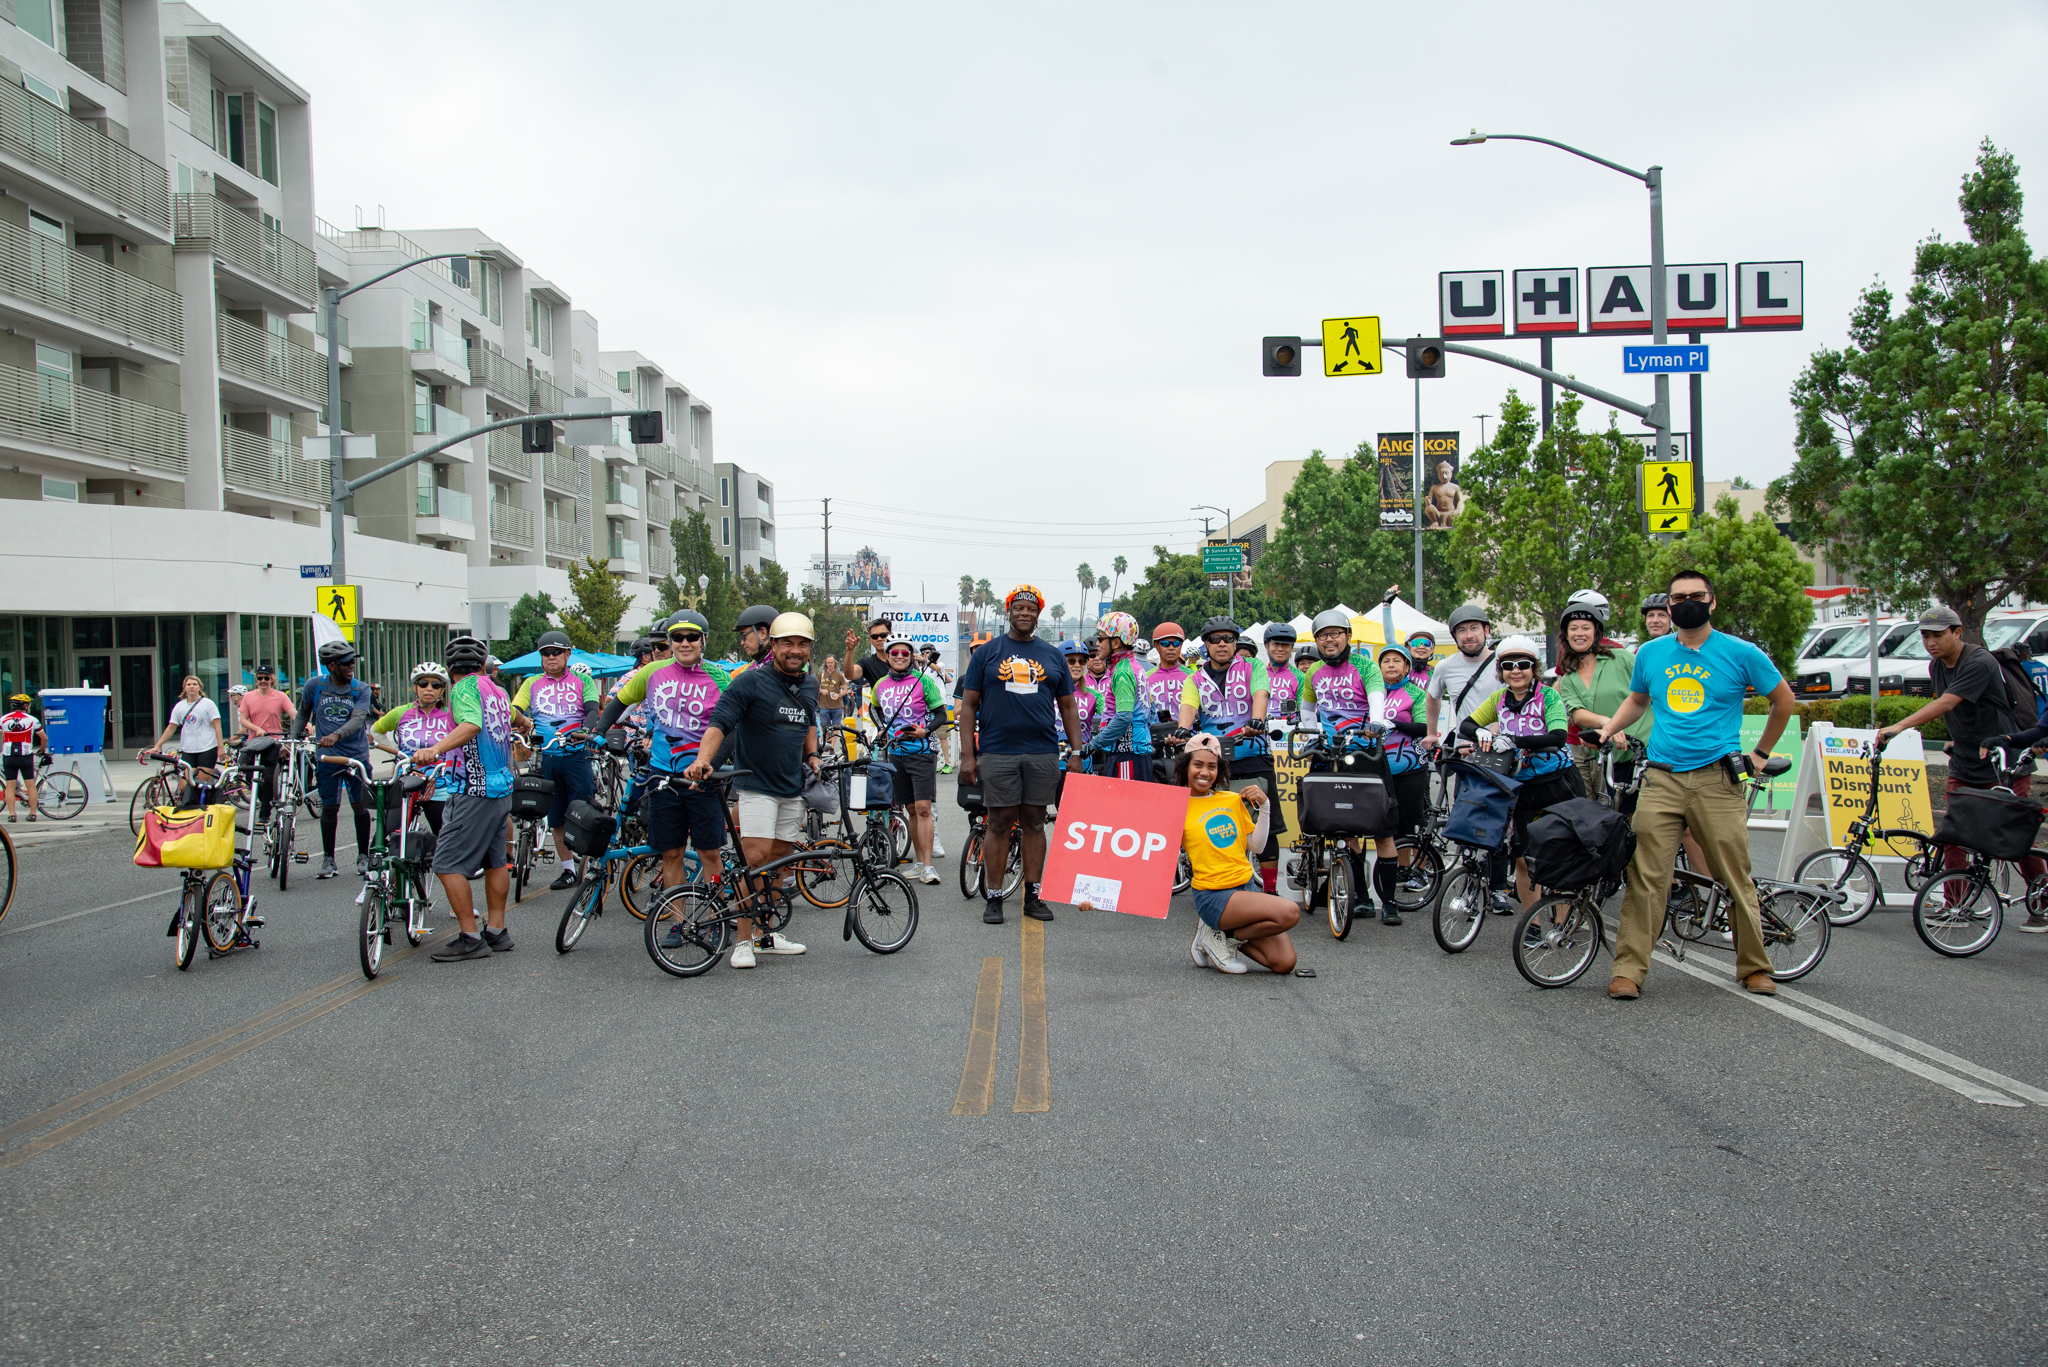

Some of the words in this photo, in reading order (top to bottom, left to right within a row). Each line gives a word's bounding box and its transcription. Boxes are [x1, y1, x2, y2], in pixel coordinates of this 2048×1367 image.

[1629, 352, 1683, 369] Lyman
[301, 565, 321, 575] Lyman
[1016, 591, 1036, 602] LONDON
[881, 611, 950, 622] CICLAVIA
[891, 624, 917, 632] MEET
[922, 624, 941, 632] THE
[911, 635, 949, 643] WOODS
[1665, 663, 1711, 679] STAFF
[1225, 670, 1246, 684] UN
[1272, 677, 1291, 688] UN
[1333, 673, 1353, 687] UN
[556, 682, 576, 692] UN
[680, 682, 708, 700] UN
[896, 684, 914, 695] UN
[1225, 684, 1247, 700] FO
[557, 692, 578, 703] FO
[1270, 688, 1289, 699] FO
[1332, 687, 1354, 701] FO
[1671, 689, 1701, 697] CICLA
[894, 696, 913, 707] FO
[1681, 696, 1701, 704] VIA
[559, 704, 578, 715] LD
[678, 698, 704, 715] FO
[779, 706, 805, 716] CICLA
[1227, 701, 1249, 716] LD
[1521, 702, 1543, 717] UN
[425, 717, 448, 731] UN
[675, 715, 701, 731] LD
[788, 715, 805, 723] VIA
[1518, 717, 1544, 732] FO
[425, 730, 448, 742] FO
[1198, 807, 1233, 823] volunteer
[1208, 823, 1234, 836] CICLA
[1219, 829, 1236, 839] VIA
[1063, 821, 1167, 861] STOP
